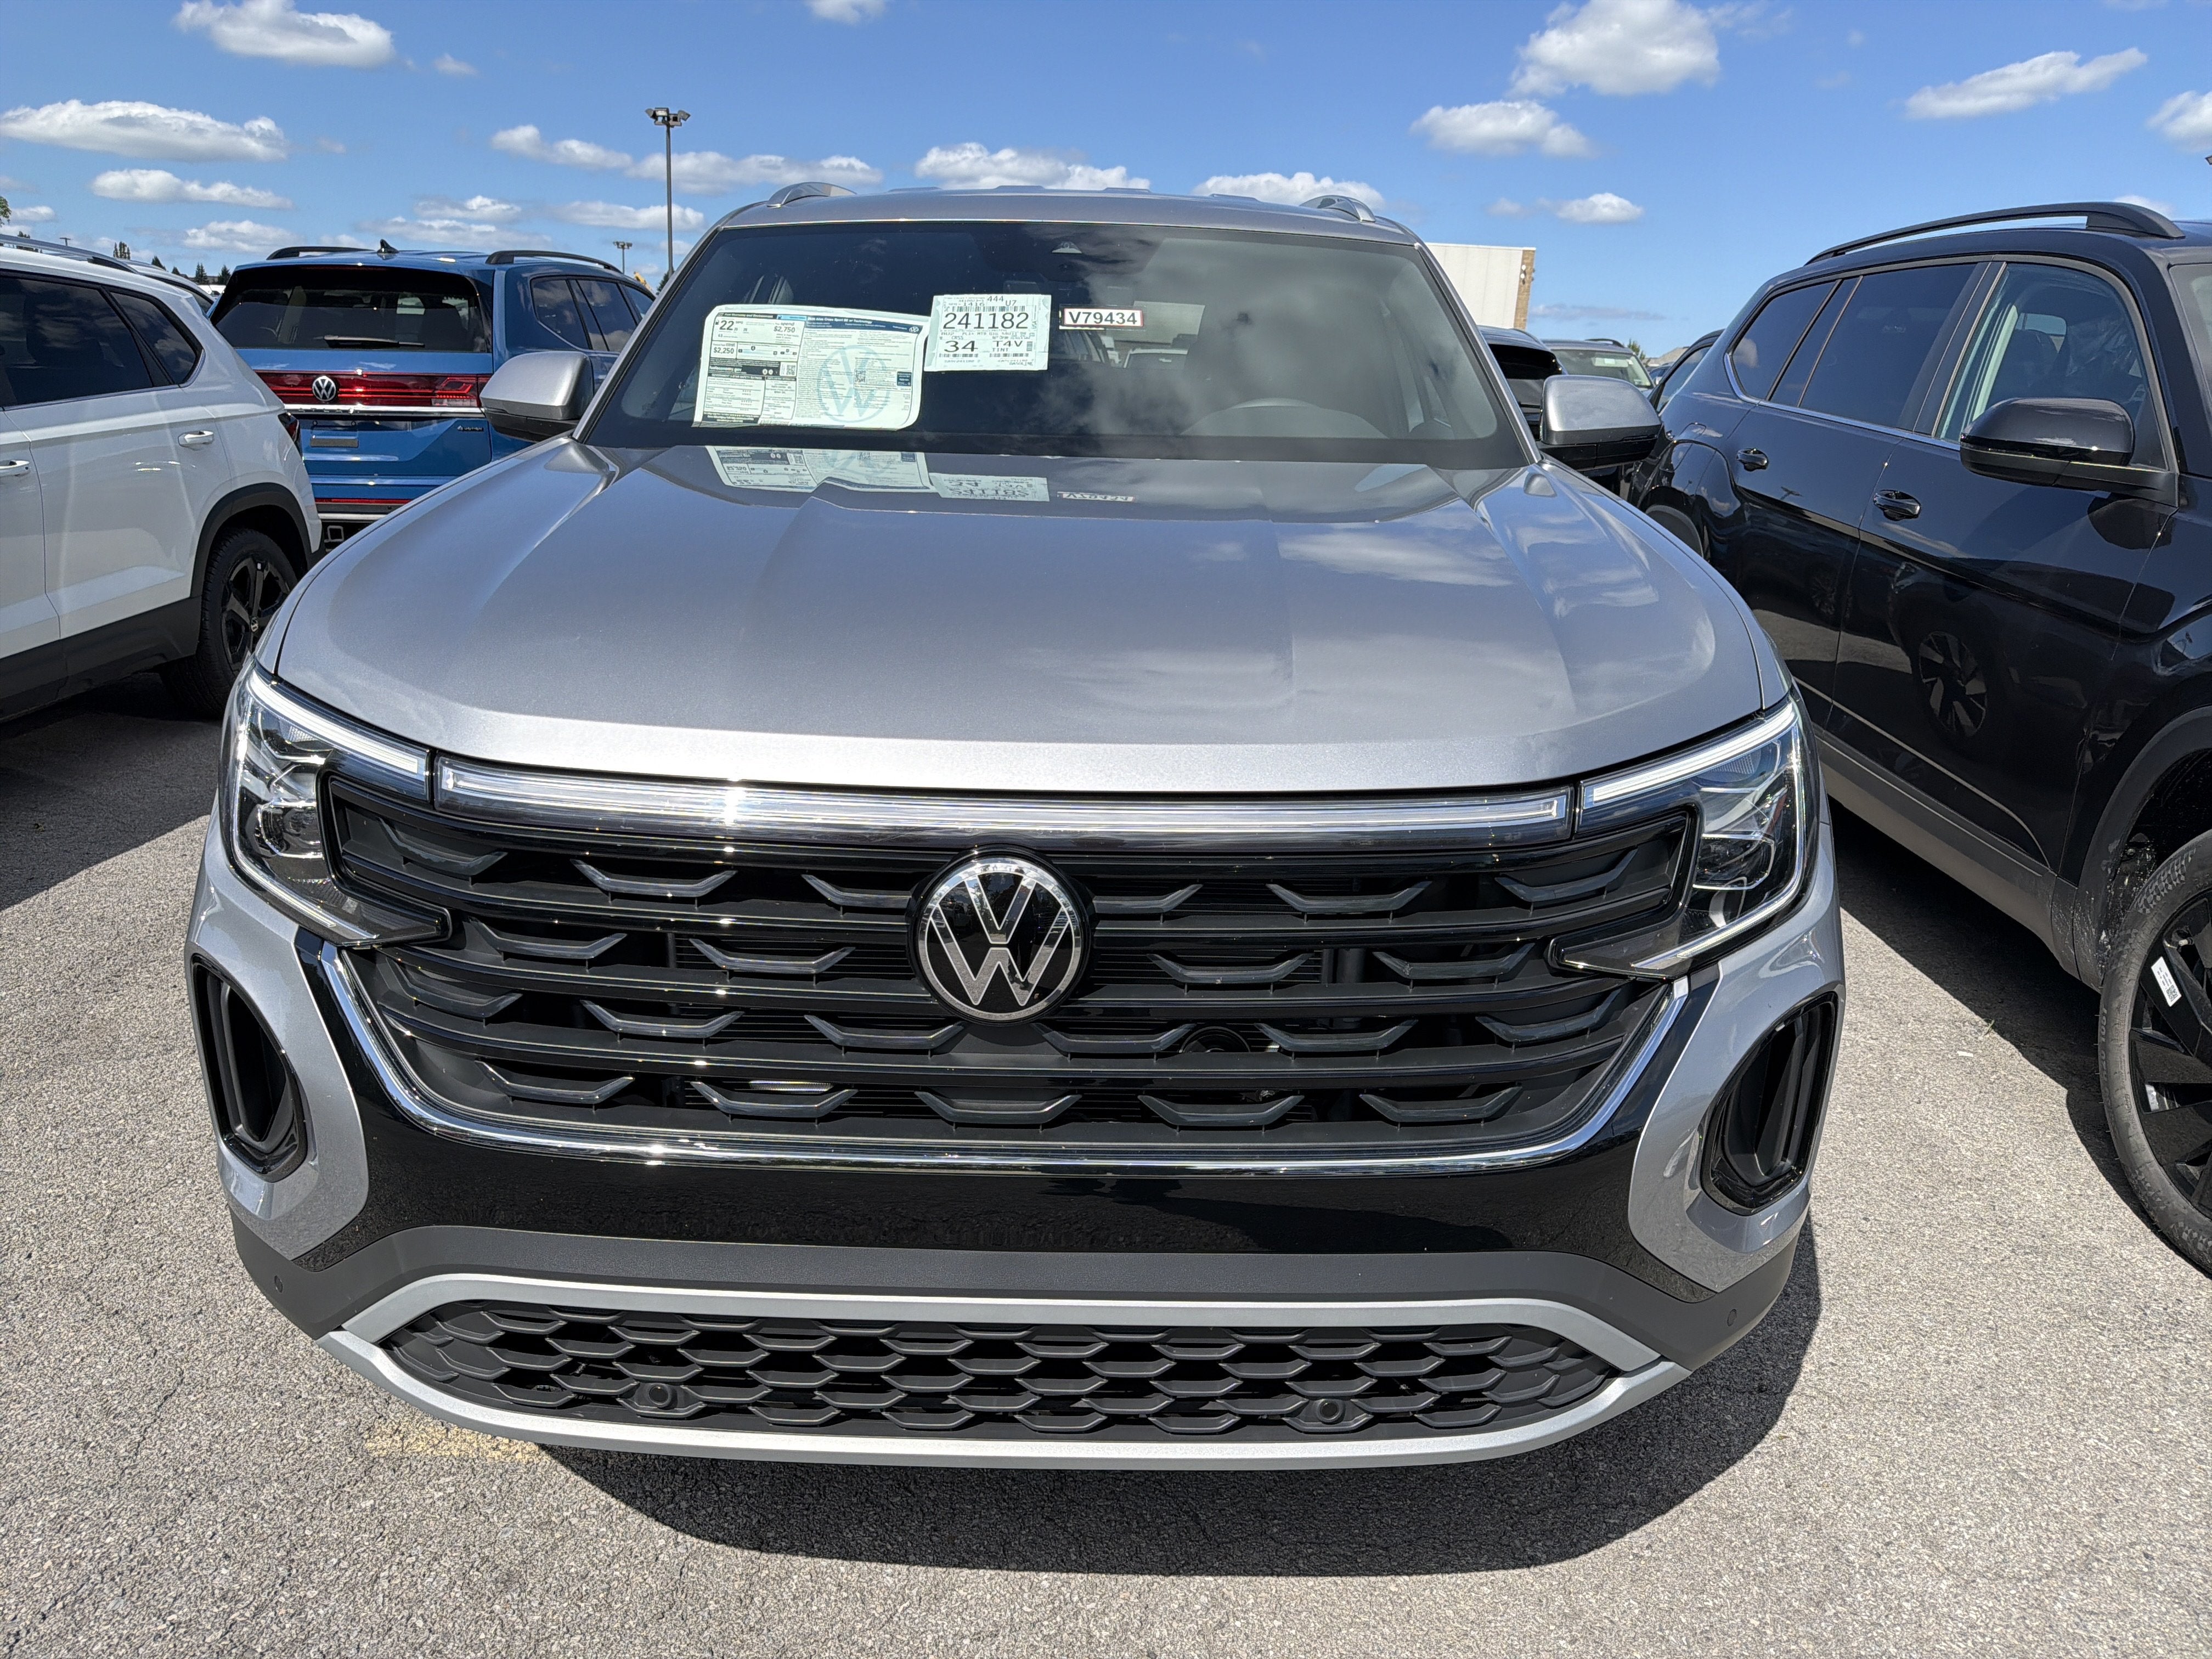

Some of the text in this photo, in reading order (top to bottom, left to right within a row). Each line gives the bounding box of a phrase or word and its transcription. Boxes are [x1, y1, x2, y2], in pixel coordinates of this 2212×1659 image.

[943, 312, 1029, 329] 241182
[1068, 311, 1137, 325] V79434
[719, 320, 735, 331] 22
[944, 340, 979, 353] 34
[923, 865, 1076, 1015] VW
